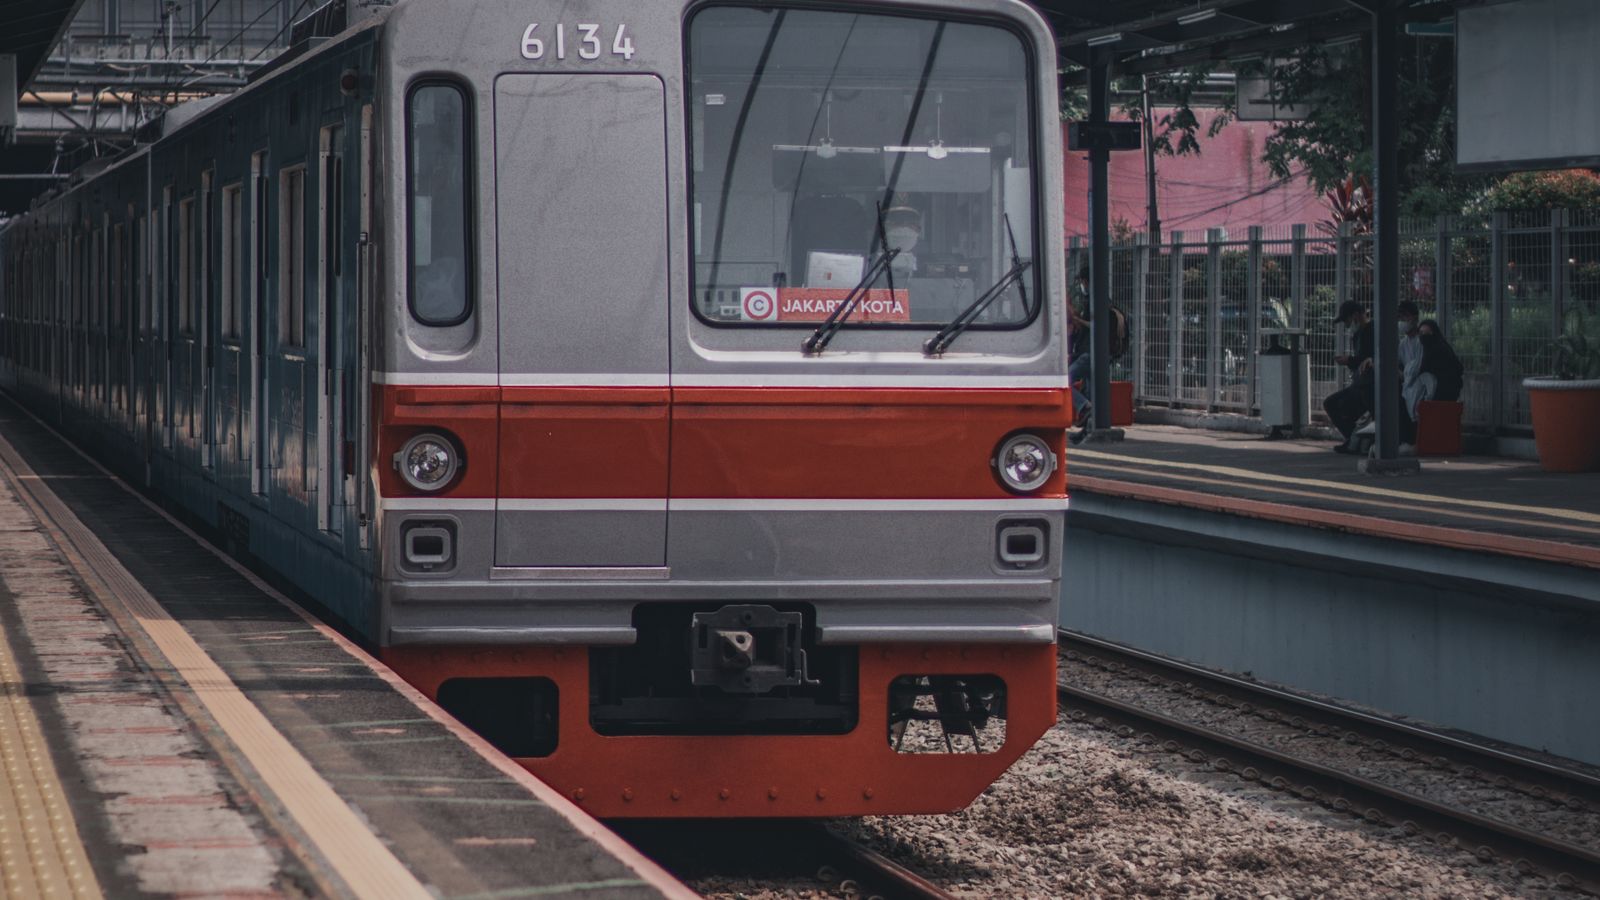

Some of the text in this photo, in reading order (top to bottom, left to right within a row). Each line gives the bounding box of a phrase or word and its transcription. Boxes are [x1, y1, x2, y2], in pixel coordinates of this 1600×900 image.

[521, 23, 635, 60] 6134
[753, 299, 764, 311] C
[860, 300, 904, 314] KOTA
